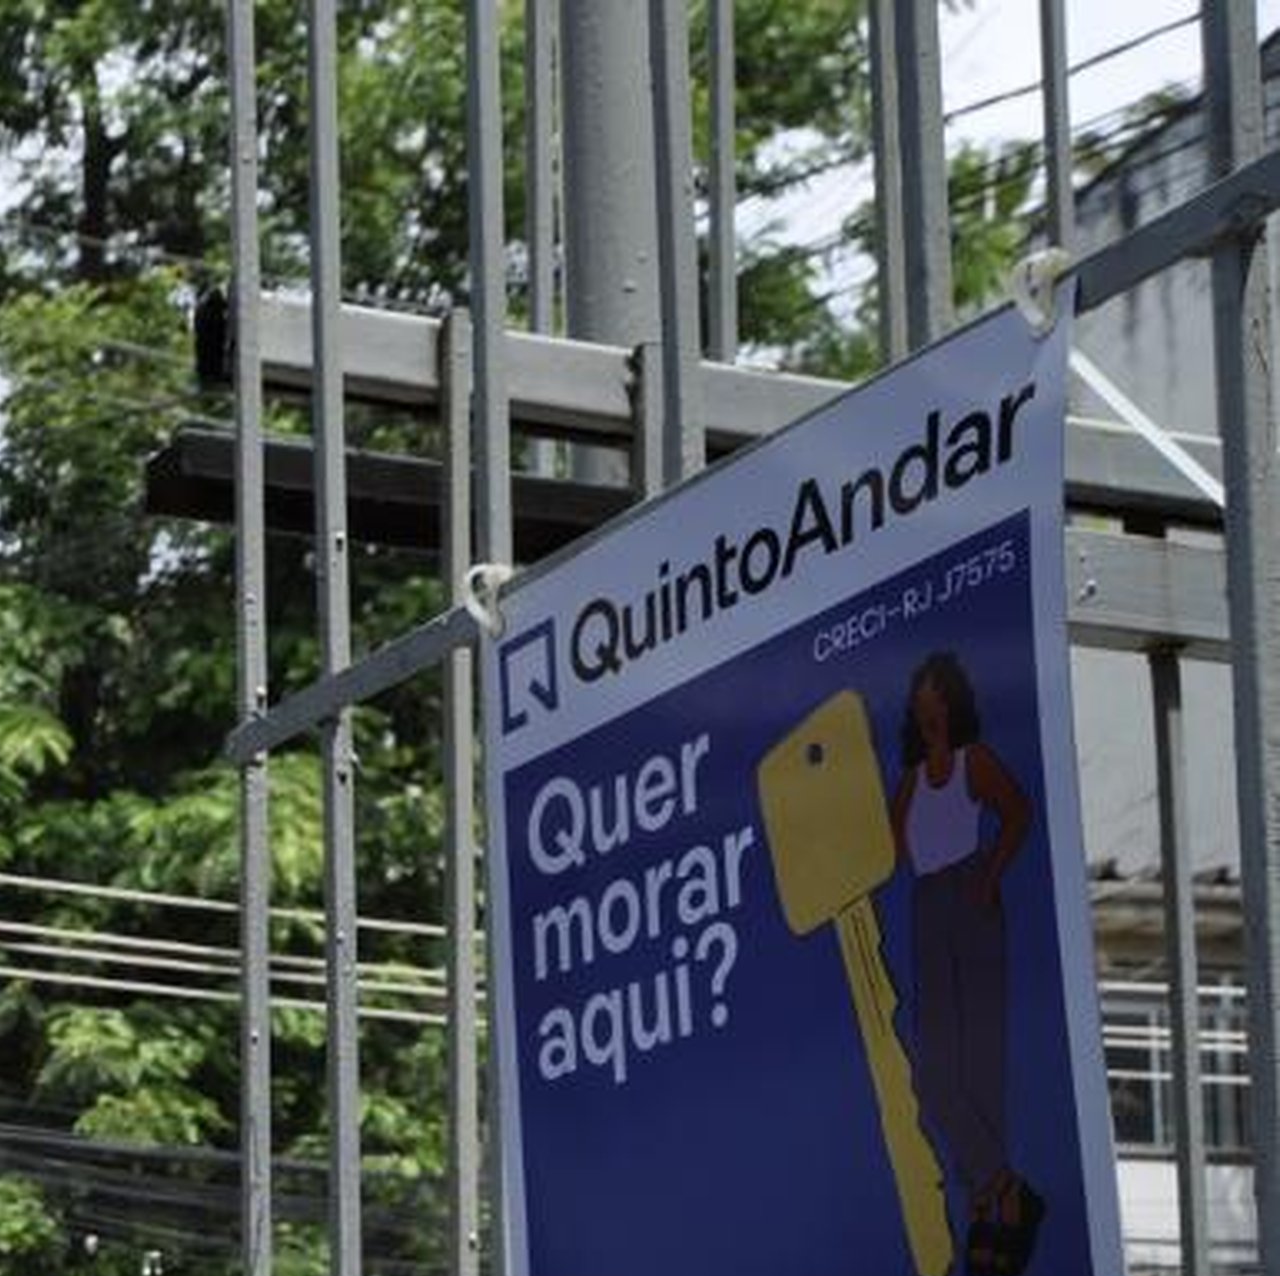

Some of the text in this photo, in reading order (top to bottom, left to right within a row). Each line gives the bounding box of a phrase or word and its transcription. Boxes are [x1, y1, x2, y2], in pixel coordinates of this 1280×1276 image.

[570, 384, 1036, 682] QuintoAndar
[813, 539, 1017, 662] CRECI-RJ J7575
[528, 733, 710, 875] Quer
[532, 825, 755, 982] morar
[538, 922, 739, 1084] aqui?
